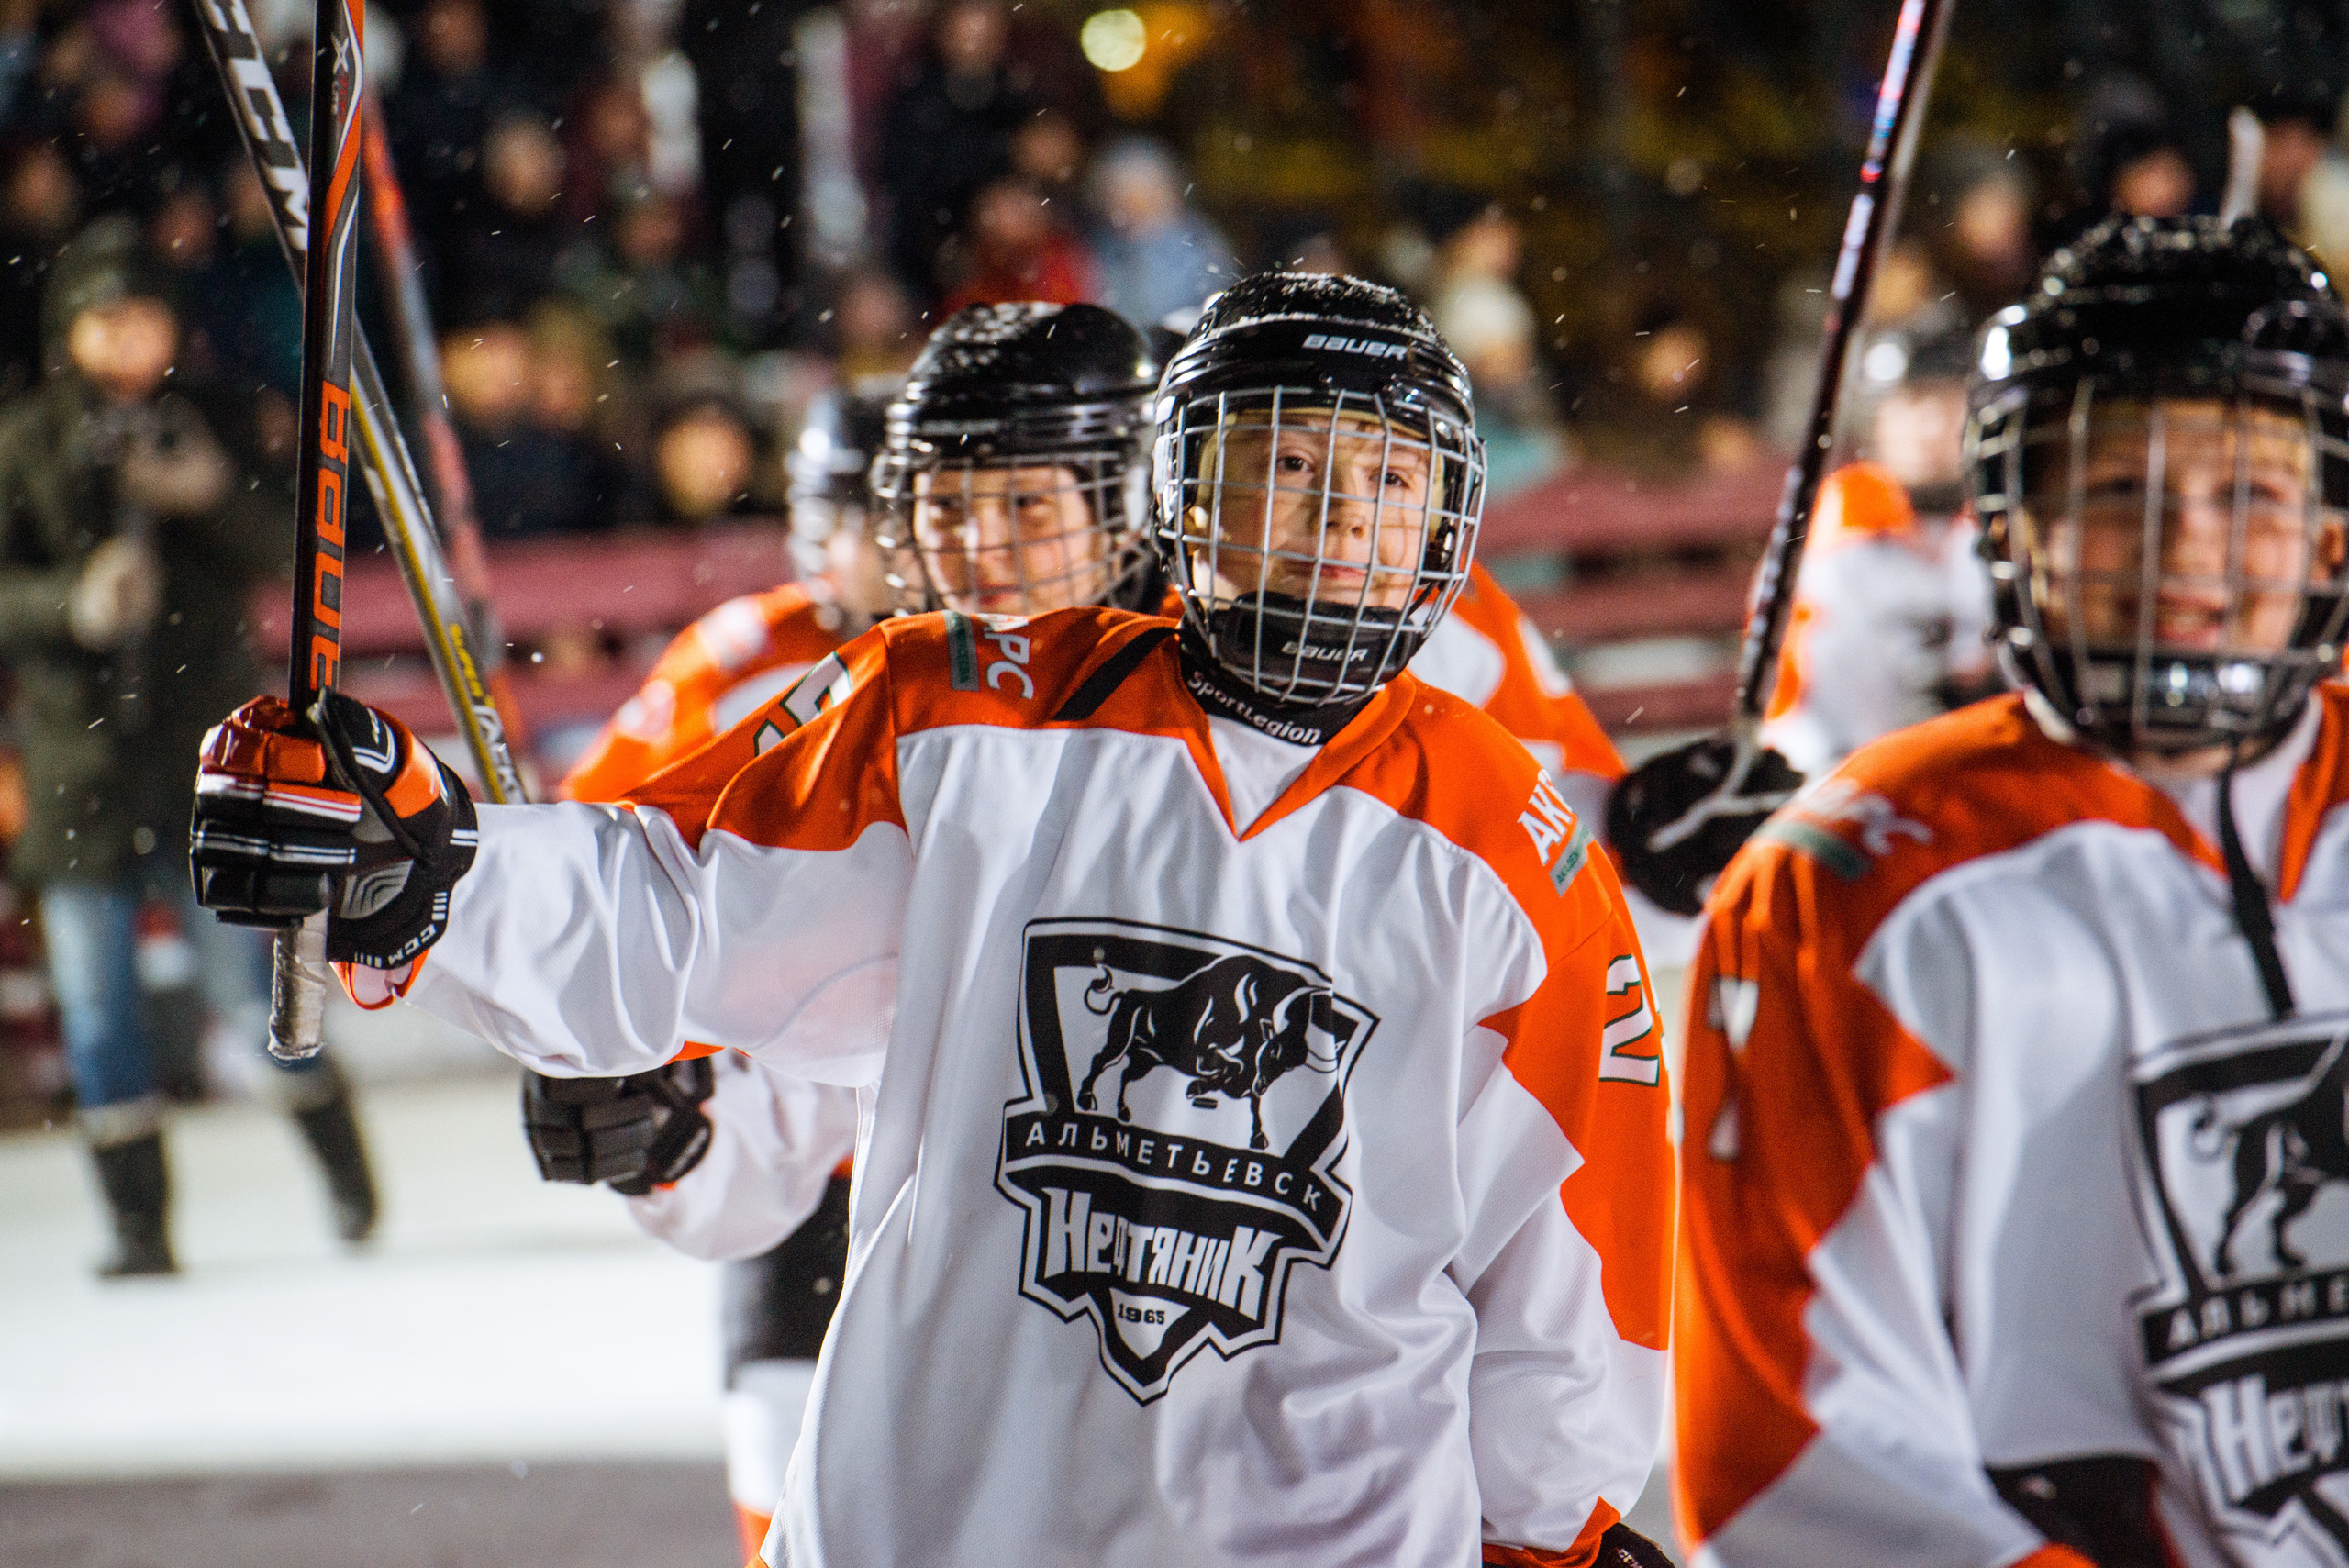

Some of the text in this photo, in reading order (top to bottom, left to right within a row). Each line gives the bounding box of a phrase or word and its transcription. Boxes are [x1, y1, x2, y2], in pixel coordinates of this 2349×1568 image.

[203, 0, 310, 251] CM
[1302, 334, 1408, 361] BAUER
[1282, 641, 1368, 662] BAUER
[388, 923, 439, 965] CCM
[1025, 1121, 1322, 1211] АЛЬМЕТЬЕВСК
[1118, 1303, 1165, 1325] 1965
